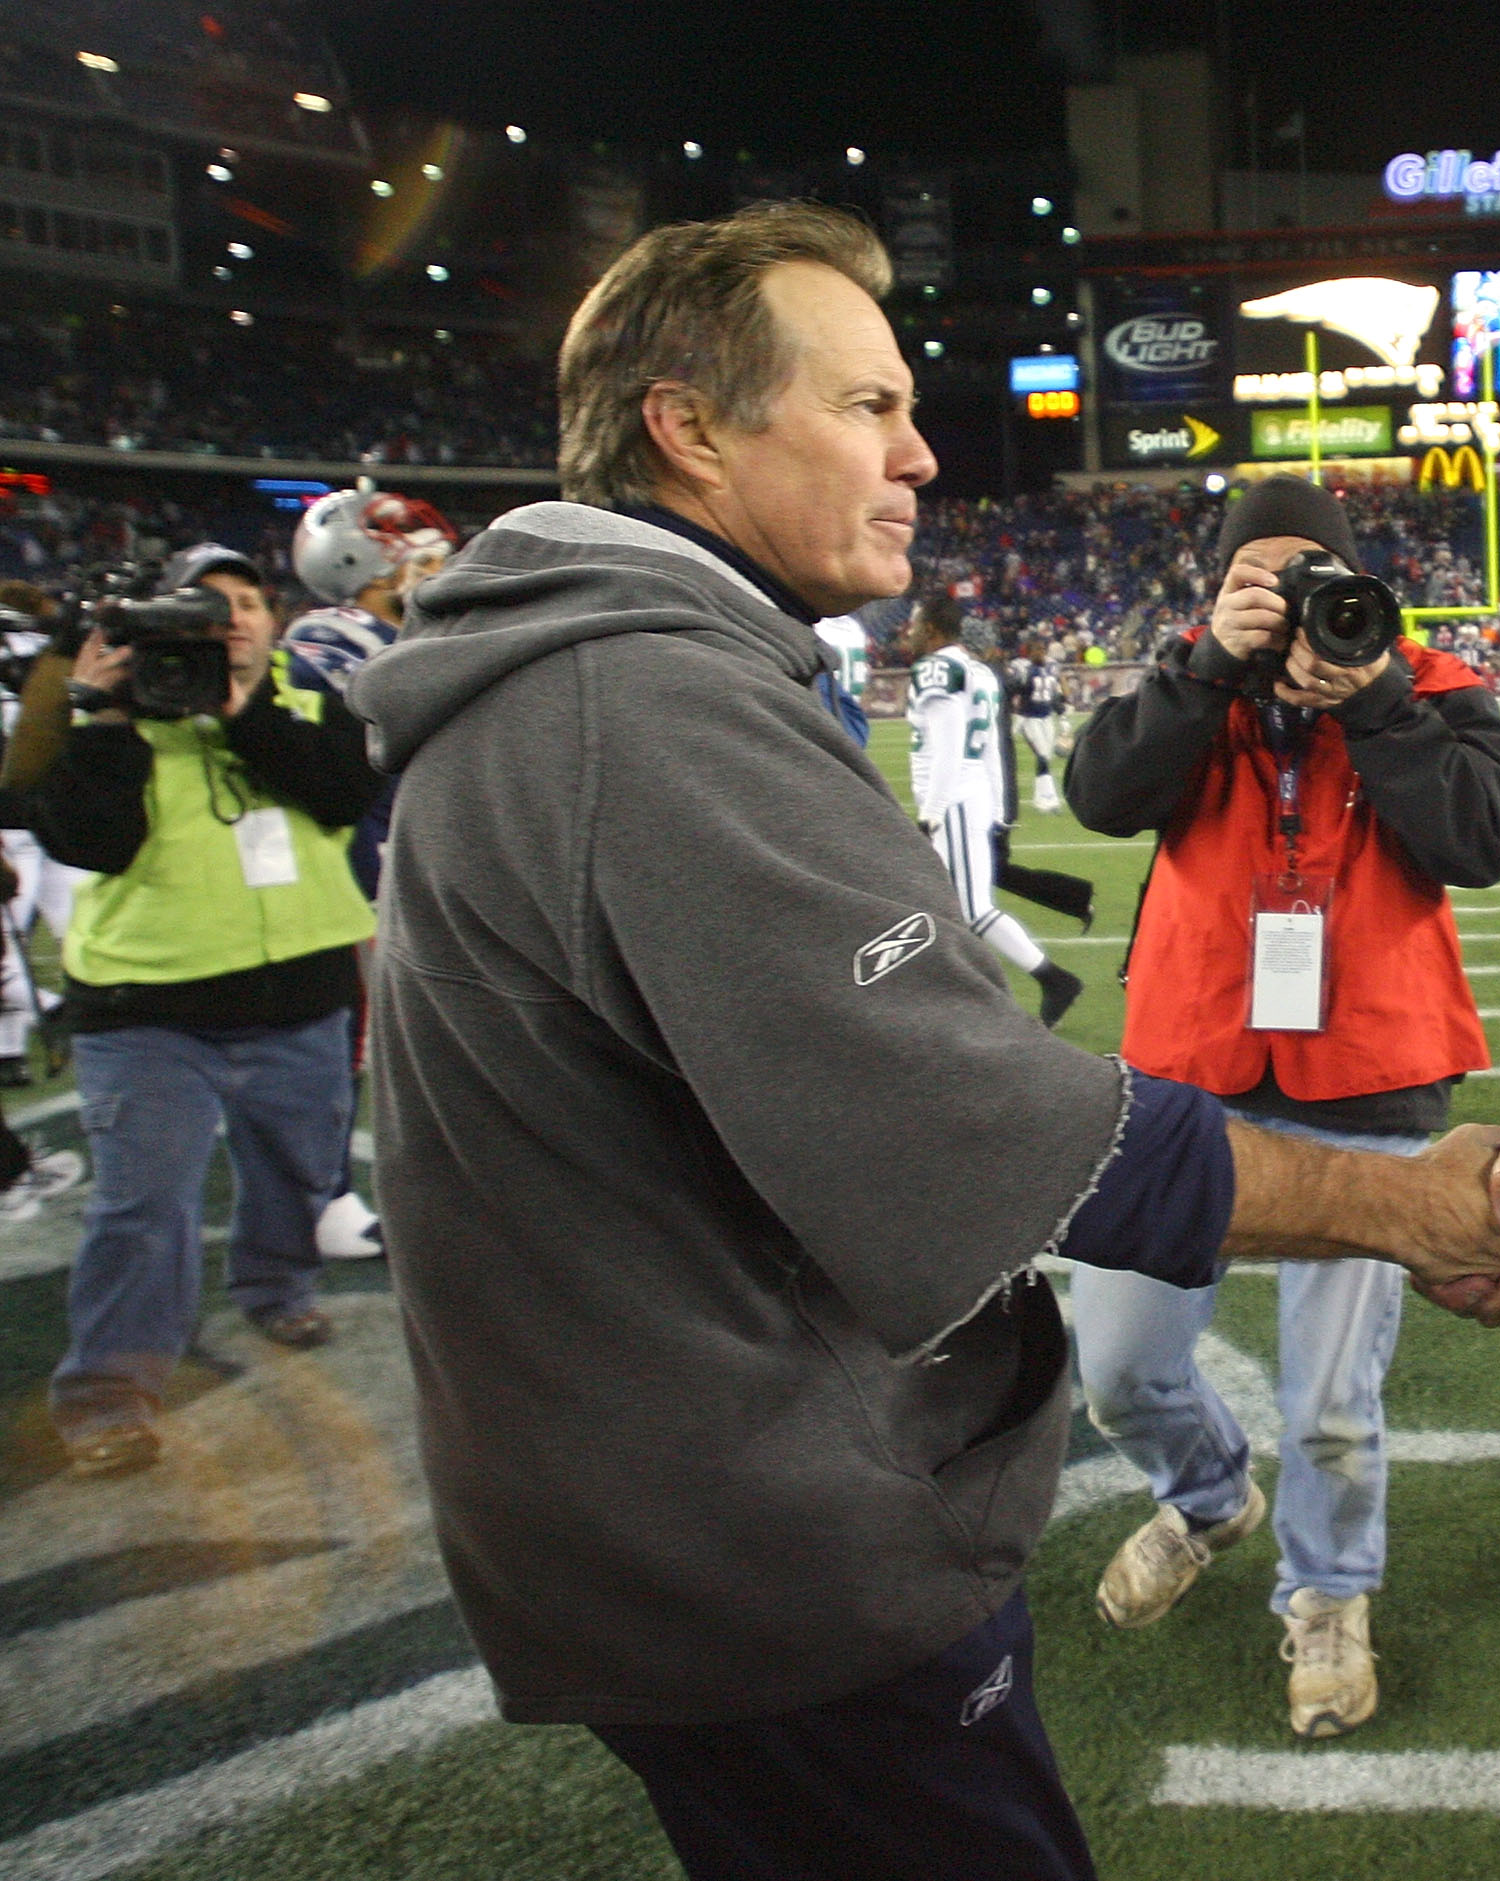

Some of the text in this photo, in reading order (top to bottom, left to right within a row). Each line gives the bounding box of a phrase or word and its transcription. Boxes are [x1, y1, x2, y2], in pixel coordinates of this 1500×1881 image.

[1130, 320, 1204, 342] BUD
[1118, 340, 1219, 363] LIGHT
[1128, 427, 1190, 454] Sprint
